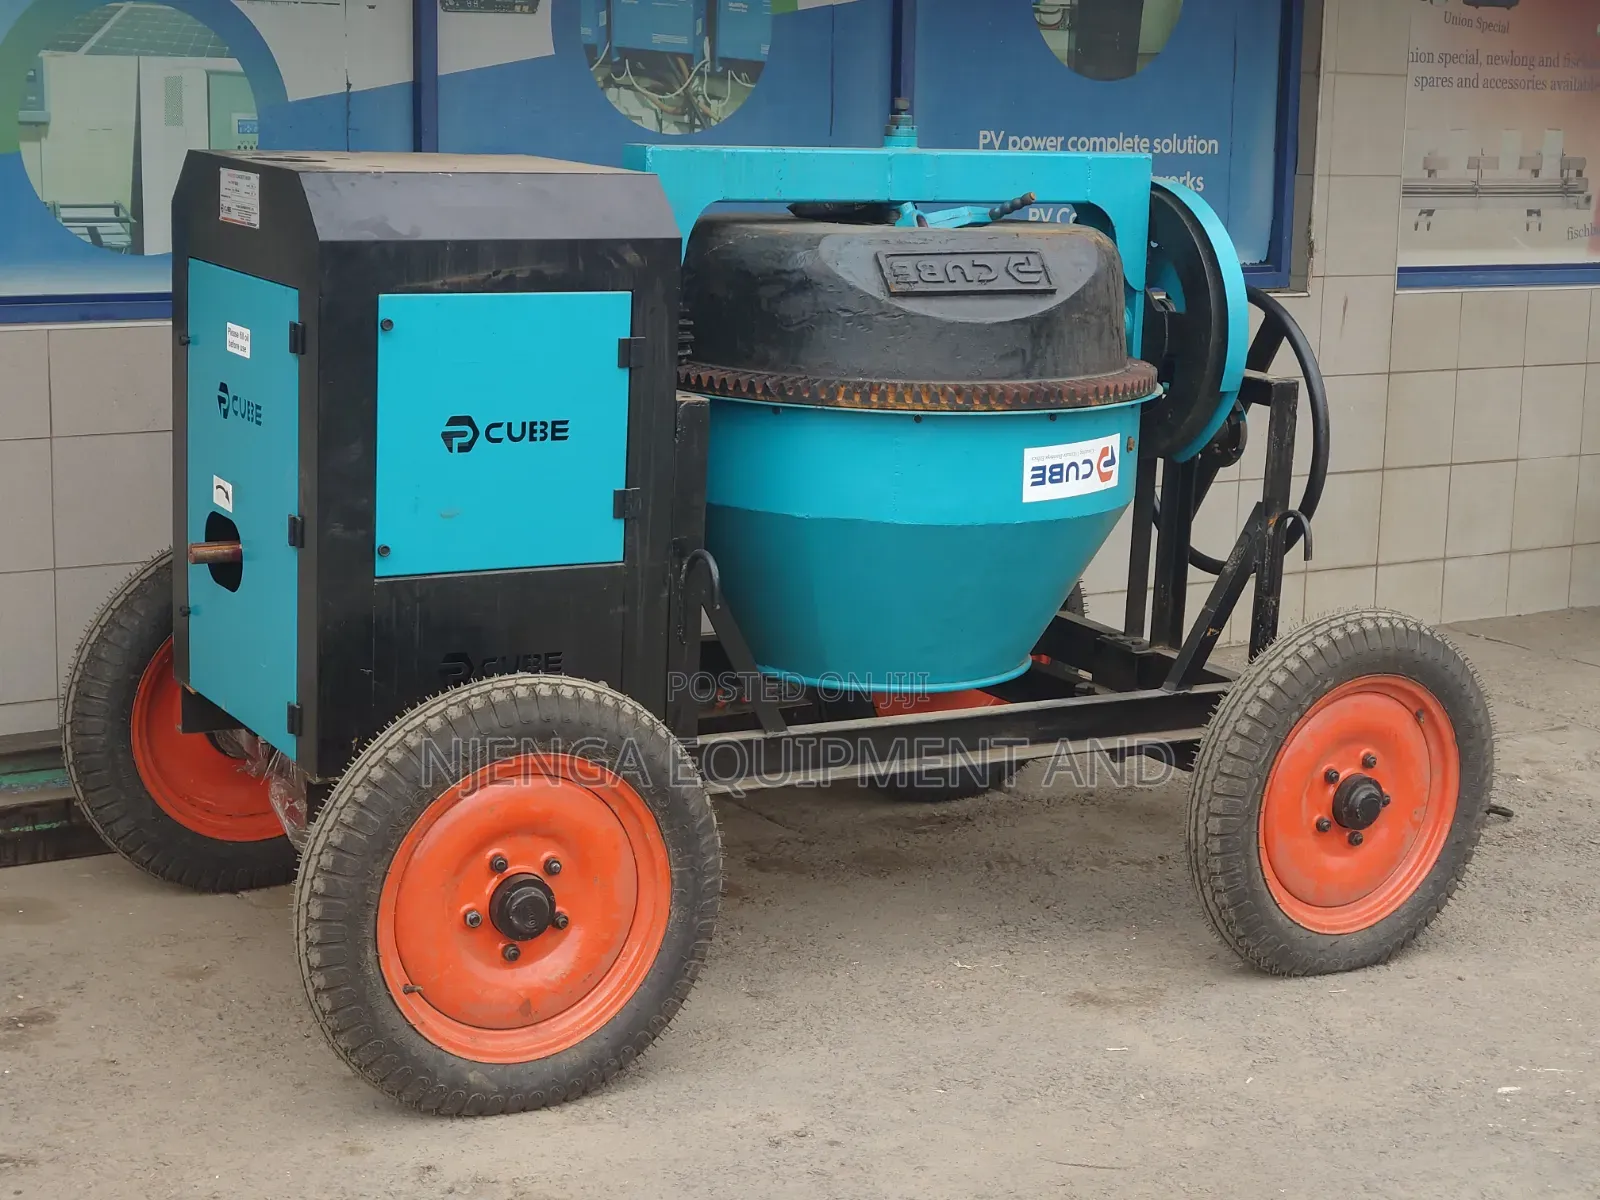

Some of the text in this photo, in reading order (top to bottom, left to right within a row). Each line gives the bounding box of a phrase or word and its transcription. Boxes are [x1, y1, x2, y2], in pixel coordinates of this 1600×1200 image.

[1444, 11, 1510, 34] Union Special
[1437, 49, 1483, 66] special,
[1486, 50, 1535, 70] newlong
[1538, 53, 1560, 68] and
[1414, 74, 1454, 91] spares
[1457, 73, 1479, 89] and
[1482, 75, 1547, 90] accessories
[979, 130, 1219, 155] PV power complete solution
[1028, 207, 1054, 222] PV
[892, 259, 998, 285] CUBE
[231, 395, 262, 427] CUBE
[485, 420, 570, 443] CUBE
[1030, 458, 1094, 487] CUBE
